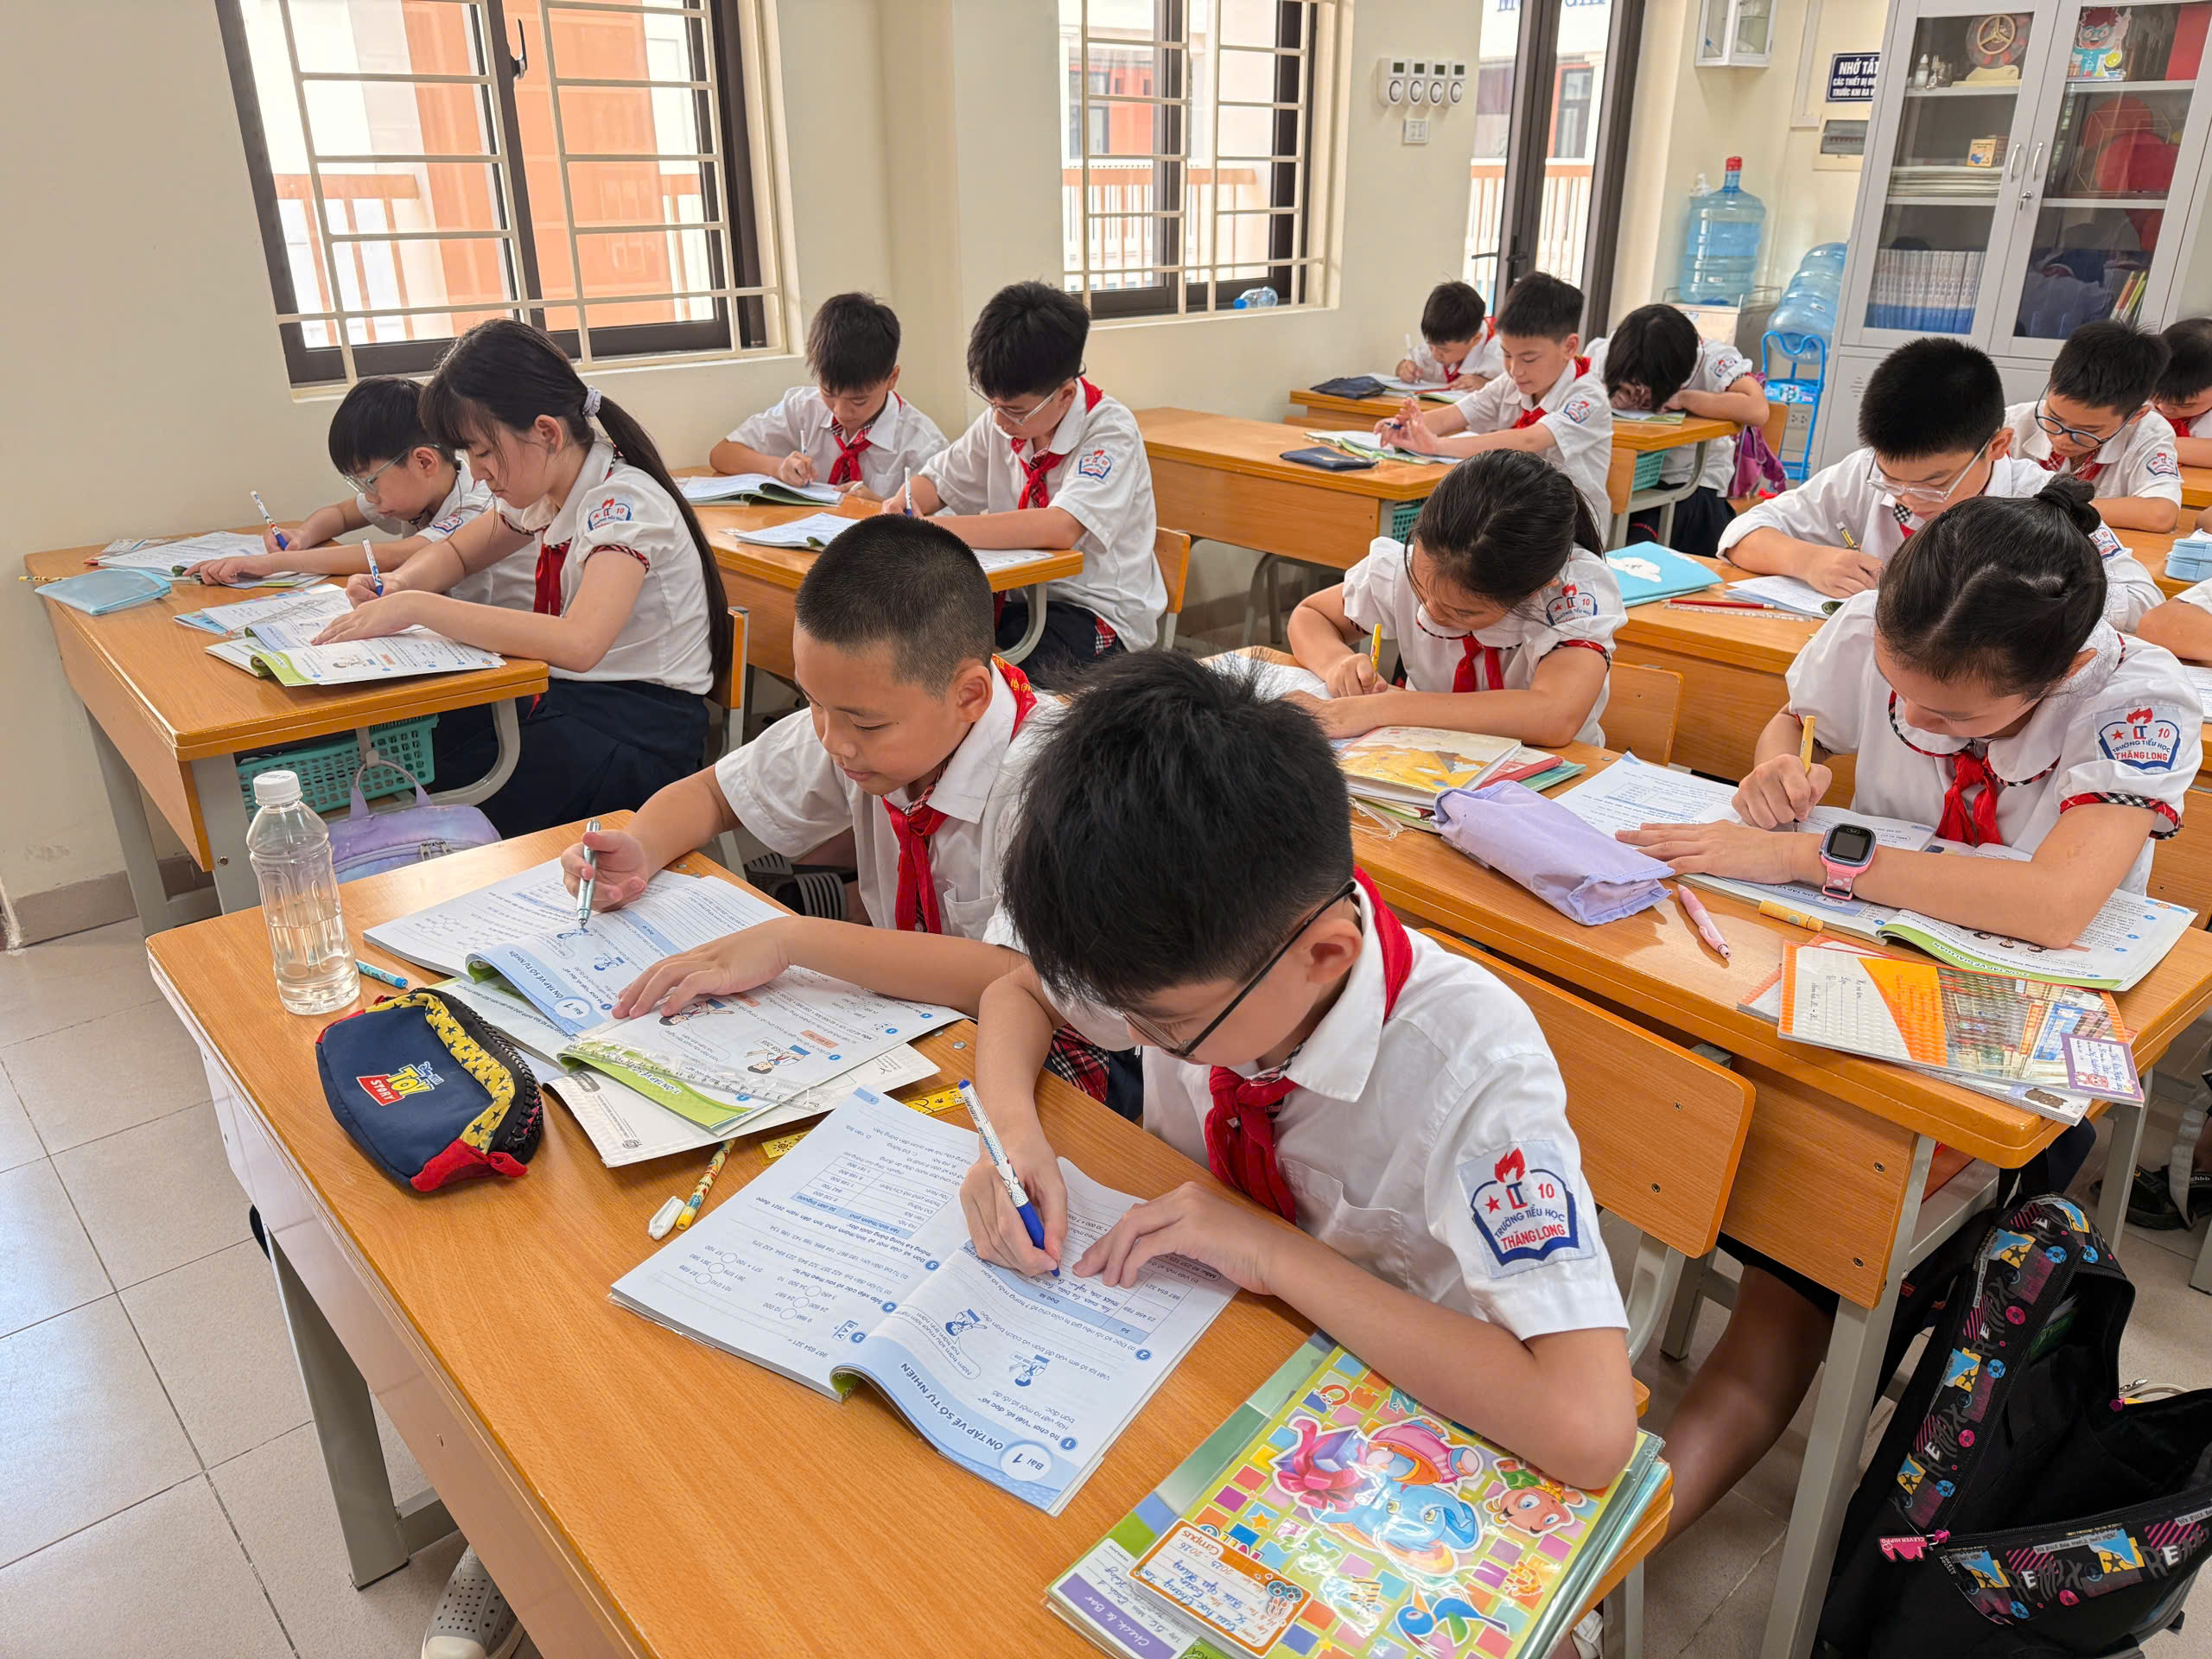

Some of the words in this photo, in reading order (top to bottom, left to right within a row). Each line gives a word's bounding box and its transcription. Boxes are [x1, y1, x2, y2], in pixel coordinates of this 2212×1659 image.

[1839, 57, 1862, 74] NHỚ
[2158, 728, 2171, 738] 10
[2115, 750, 2145, 760] THĂNG
[2146, 752, 2167, 760] LONG
[385, 1067, 429, 1096] TOY
[370, 1079, 395, 1100] STORY
[1538, 1184, 1554, 1198] 10
[1495, 1212, 1524, 1238] TRƯỜNG
[1525, 1205, 1542, 1217] TIỂU
[1545, 1210, 1566, 1222] HỌC
[1501, 1230, 1536, 1250] THĂNG
[1537, 1224, 1566, 1241] LONG
[1008, 1293, 1026, 1306] trong
[1122, 1305, 1135, 1313] 789
[1134, 1310, 1147, 1319] 456
[1049, 1312, 1065, 1321] của
[990, 1320, 1006, 1332] bạn
[1081, 1325, 1096, 1334] nêu
[1003, 1330, 1022, 1342] cách
[1030, 1342, 1046, 1352] bạn
[1111, 1338, 1128, 1348] Đọc
[1044, 1348, 1056, 1357] đố
[1053, 1353, 1068, 1362] vừa
[1067, 1358, 1079, 1367] em
[899, 1362, 929, 1394] NHIÊN
[1096, 1370, 1111, 1381] Viết
[925, 1391, 943, 1408] TỰ
[990, 1389, 1003, 1398] đố
[1000, 1395, 1012, 1403] rồi
[937, 1405, 955, 1421] SỐ
[989, 1402, 1005, 1413] đọc
[1018, 1403, 1034, 1414] một
[950, 1416, 968, 1432] VỀ
[1039, 1414, 1054, 1425] viết
[1058, 1412, 1075, 1424] bạn
[1032, 1423, 1049, 1435] chơi
[1053, 1420, 1069, 1431] Hãy
[965, 1426, 988, 1442] TẬP
[1048, 1432, 1060, 1440] Trò
[985, 1437, 1004, 1451] ÔN
[1011, 1452, 1026, 1465] 1
[1026, 1457, 1044, 1470] Bài
[1180, 1528, 1220, 1556] Campus
[1083, 1592, 1105, 1615] Bar
[1116, 1618, 1149, 1649] Check
